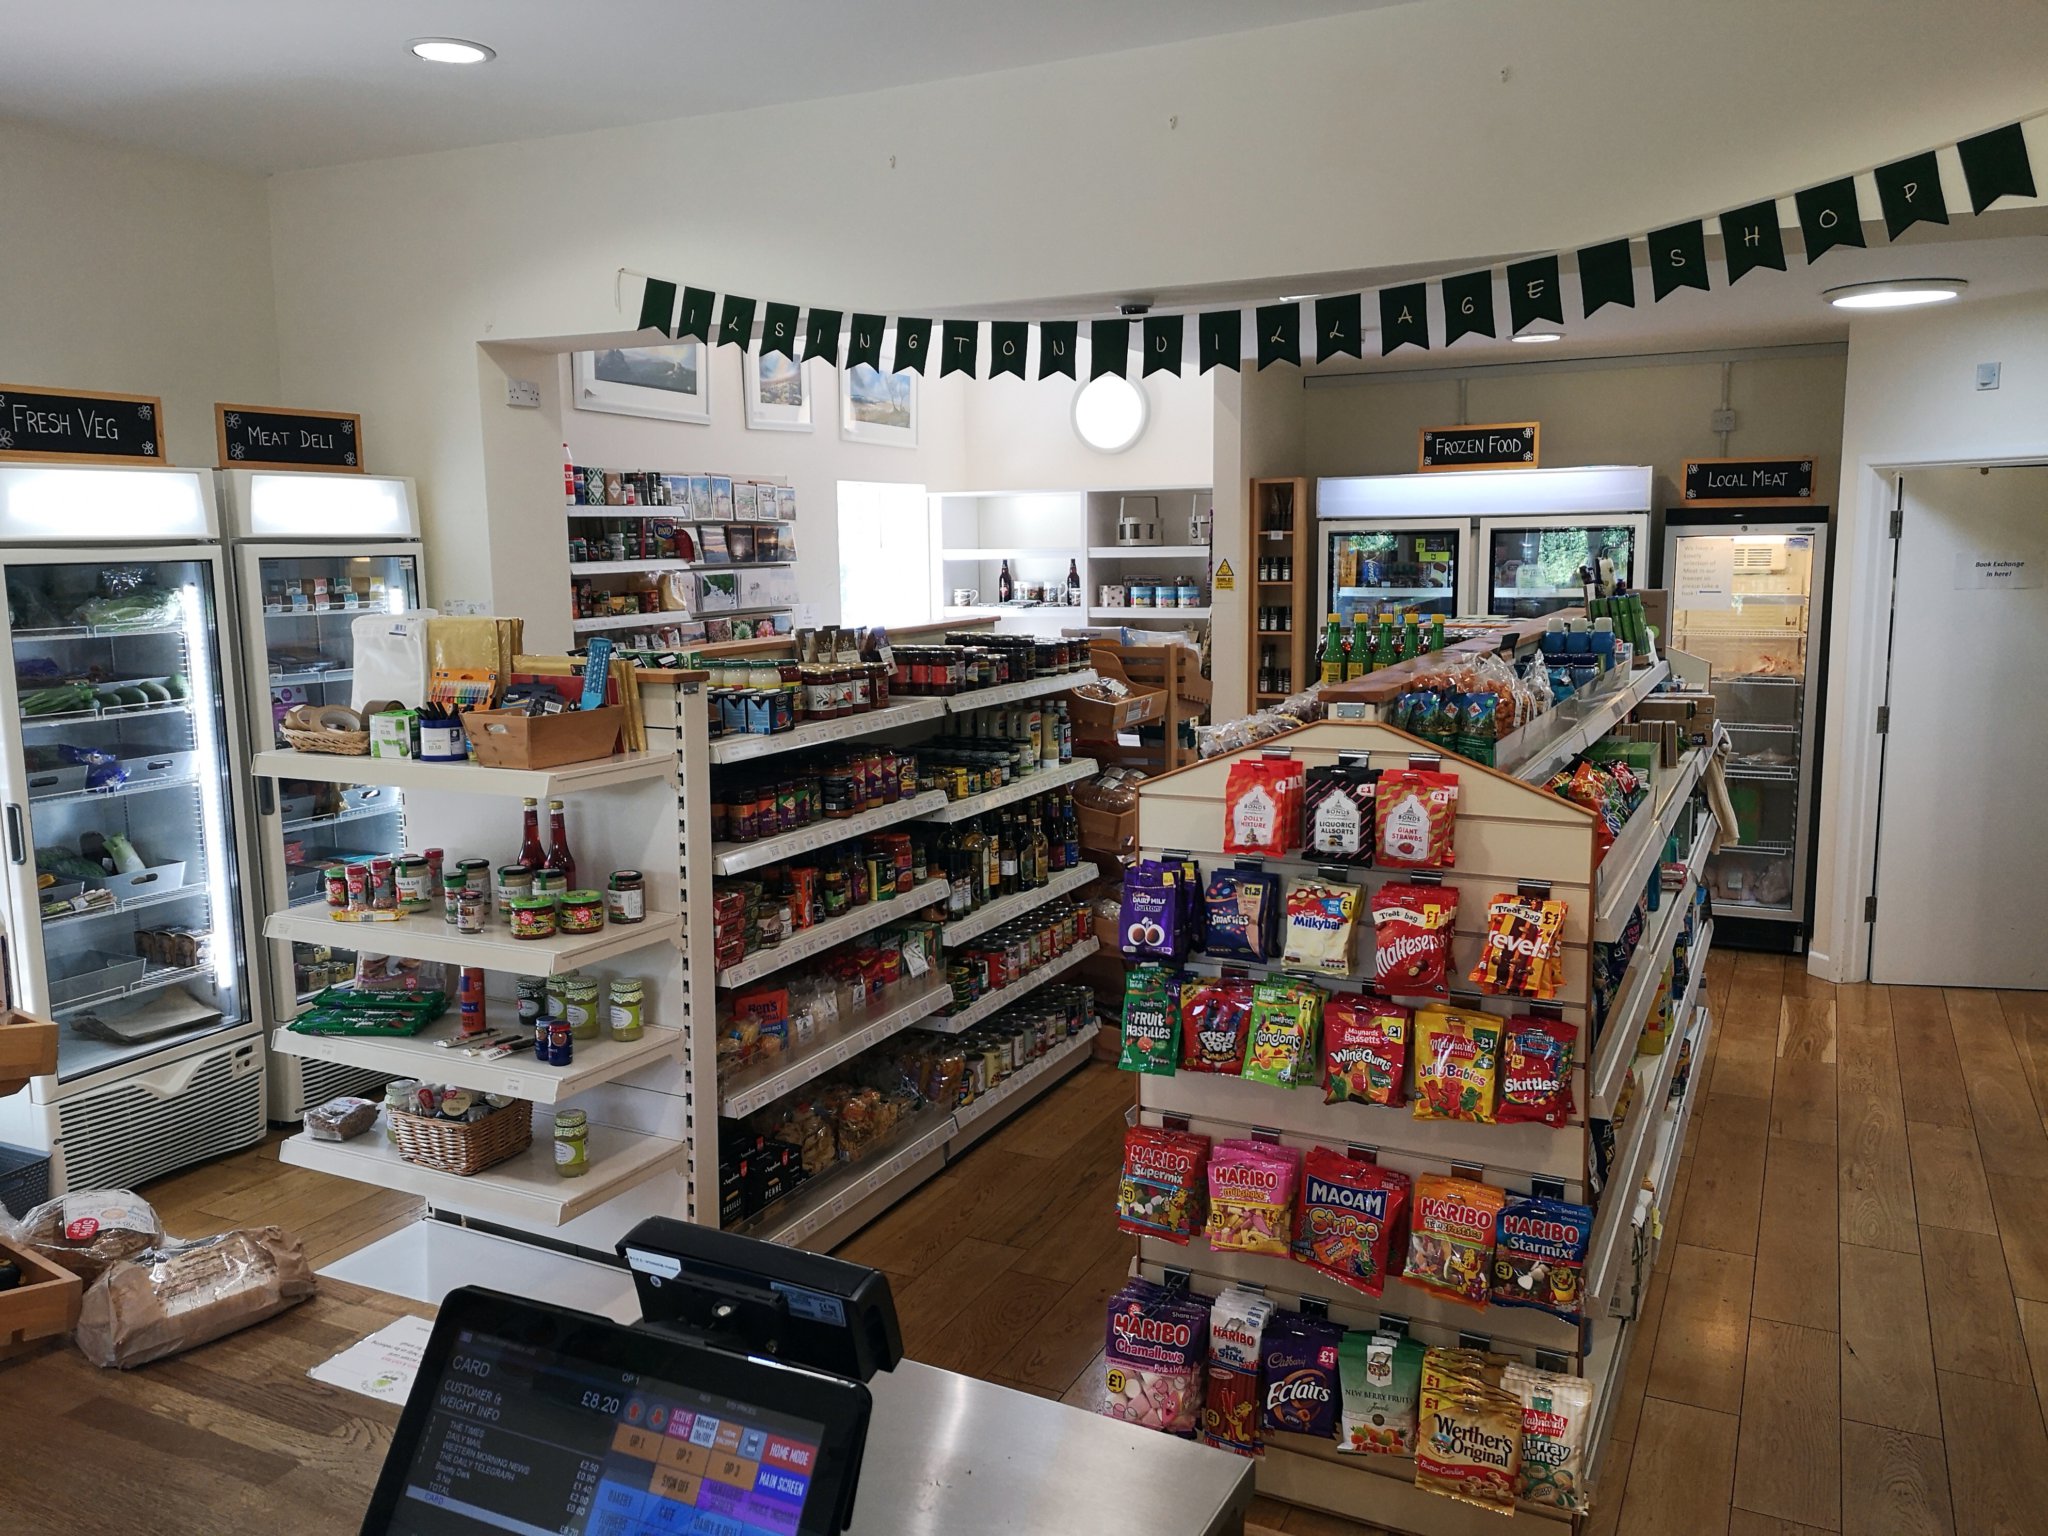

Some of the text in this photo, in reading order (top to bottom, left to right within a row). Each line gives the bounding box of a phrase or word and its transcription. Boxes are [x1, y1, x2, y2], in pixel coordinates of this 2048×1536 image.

[1155, 278, 1545, 353] VILLAGE
[1669, 182, 1918, 267] SHOP
[12, 404, 119, 440] FRESH VEG
[248, 426, 333, 449] MEAT DELI
[1436, 435, 1522, 455] FROZEN FOOD
[1708, 471, 1788, 487] LOCAL MEAT
[1360, 786, 1372, 794] £1
[1433, 793, 1445, 801] £1
[1243, 803, 1266, 811] BONDS
[1243, 815, 1264, 823] DOLLY
[1319, 821, 1356, 829] LIQUORICE
[1398, 814, 1421, 822] BONDS
[1391, 834, 1423, 843] STRAWBS
[1244, 887, 1261, 896] £1.25
[1342, 901, 1352, 910] £1
[1379, 911, 1418, 923] Treat bag
[1425, 911, 1438, 924] £1
[1495, 905, 1541, 923] Treat bag
[1543, 911, 1559, 925] £1
[1293, 917, 1343, 930] Milkybar
[1488, 930, 1550, 959] revels
[1301, 1000, 1313, 1010] £1
[1200, 1031, 1236, 1042] PUSH
[1256, 1029, 1301, 1050] Randoms
[1344, 1033, 1380, 1045] Bassetts
[1348, 1027, 1379, 1037] Maynards
[1388, 1026, 1401, 1037] £1
[1207, 1041, 1233, 1052] POP
[1480, 1037, 1494, 1048] £1
[1504, 1078, 1560, 1092] Skittles
[1131, 1145, 1191, 1172] HARIBO
[1134, 1163, 1184, 1185] Supermix
[1215, 1166, 1278, 1189] HARIBO
[765, 1183, 782, 1200] PENNE
[1124, 1188, 1134, 1199] £1
[1311, 1182, 1382, 1216] MAOAM
[1212, 1214, 1223, 1225] £1
[1421, 1197, 1492, 1229] HARIBO
[1504, 1215, 1579, 1244] HARIBO
[1326, 1241, 1345, 1257] MAOAM
[1510, 1236, 1571, 1259] Starmix
[1497, 1266, 1511, 1277] £1
[1172, 1311, 1190, 1319] Share
[1113, 1313, 1190, 1346] HARIBO
[1213, 1326, 1256, 1347] HARIBO
[1116, 1339, 1184, 1364] Chamallows
[1320, 1351, 1335, 1363] £1
[452, 1355, 490, 1378] CARD
[1267, 1352, 1306, 1369] Cadbury
[622, 1373, 634, 1383] OP
[1108, 1375, 1123, 1387] £1
[1426, 1375, 1440, 1388] £1
[444, 1380, 493, 1401] CUSTOMER
[1266, 1380, 1331, 1410] Eclairs
[1345, 1389, 1363, 1397] NEW
[1364, 1391, 1386, 1400] BERRY
[440, 1395, 500, 1421] WEIGHT INFO
[581, 1390, 620, 1414] £8.20
[1424, 1397, 1439, 1410] £1
[673, 1410, 693, 1425] ACTIVE
[450, 1421, 485, 1438] THE TIMES
[669, 1423, 689, 1438] CLERKS
[1434, 1414, 1513, 1454] Werther's
[446, 1431, 481, 1449] DAILY MAIL
[443, 1441, 530, 1475] WESTERN MORNING NEWS
[769, 1442, 810, 1467] HOME MODE
[1450, 1437, 1509, 1468] Original
[440, 1452, 515, 1481] THE DAILY TELEGRAPH
[580, 1459, 599, 1473] £2.50
[1420, 1459, 1465, 1476] Butter Candies
[429, 1481, 450, 1496] TOTAL
[759, 1471, 804, 1497] MAIN SCREEN
[424, 1493, 444, 1505] CARD
[608, 1489, 632, 1507] BAKERY
[694, 1516, 715, 1533] DAIRY
